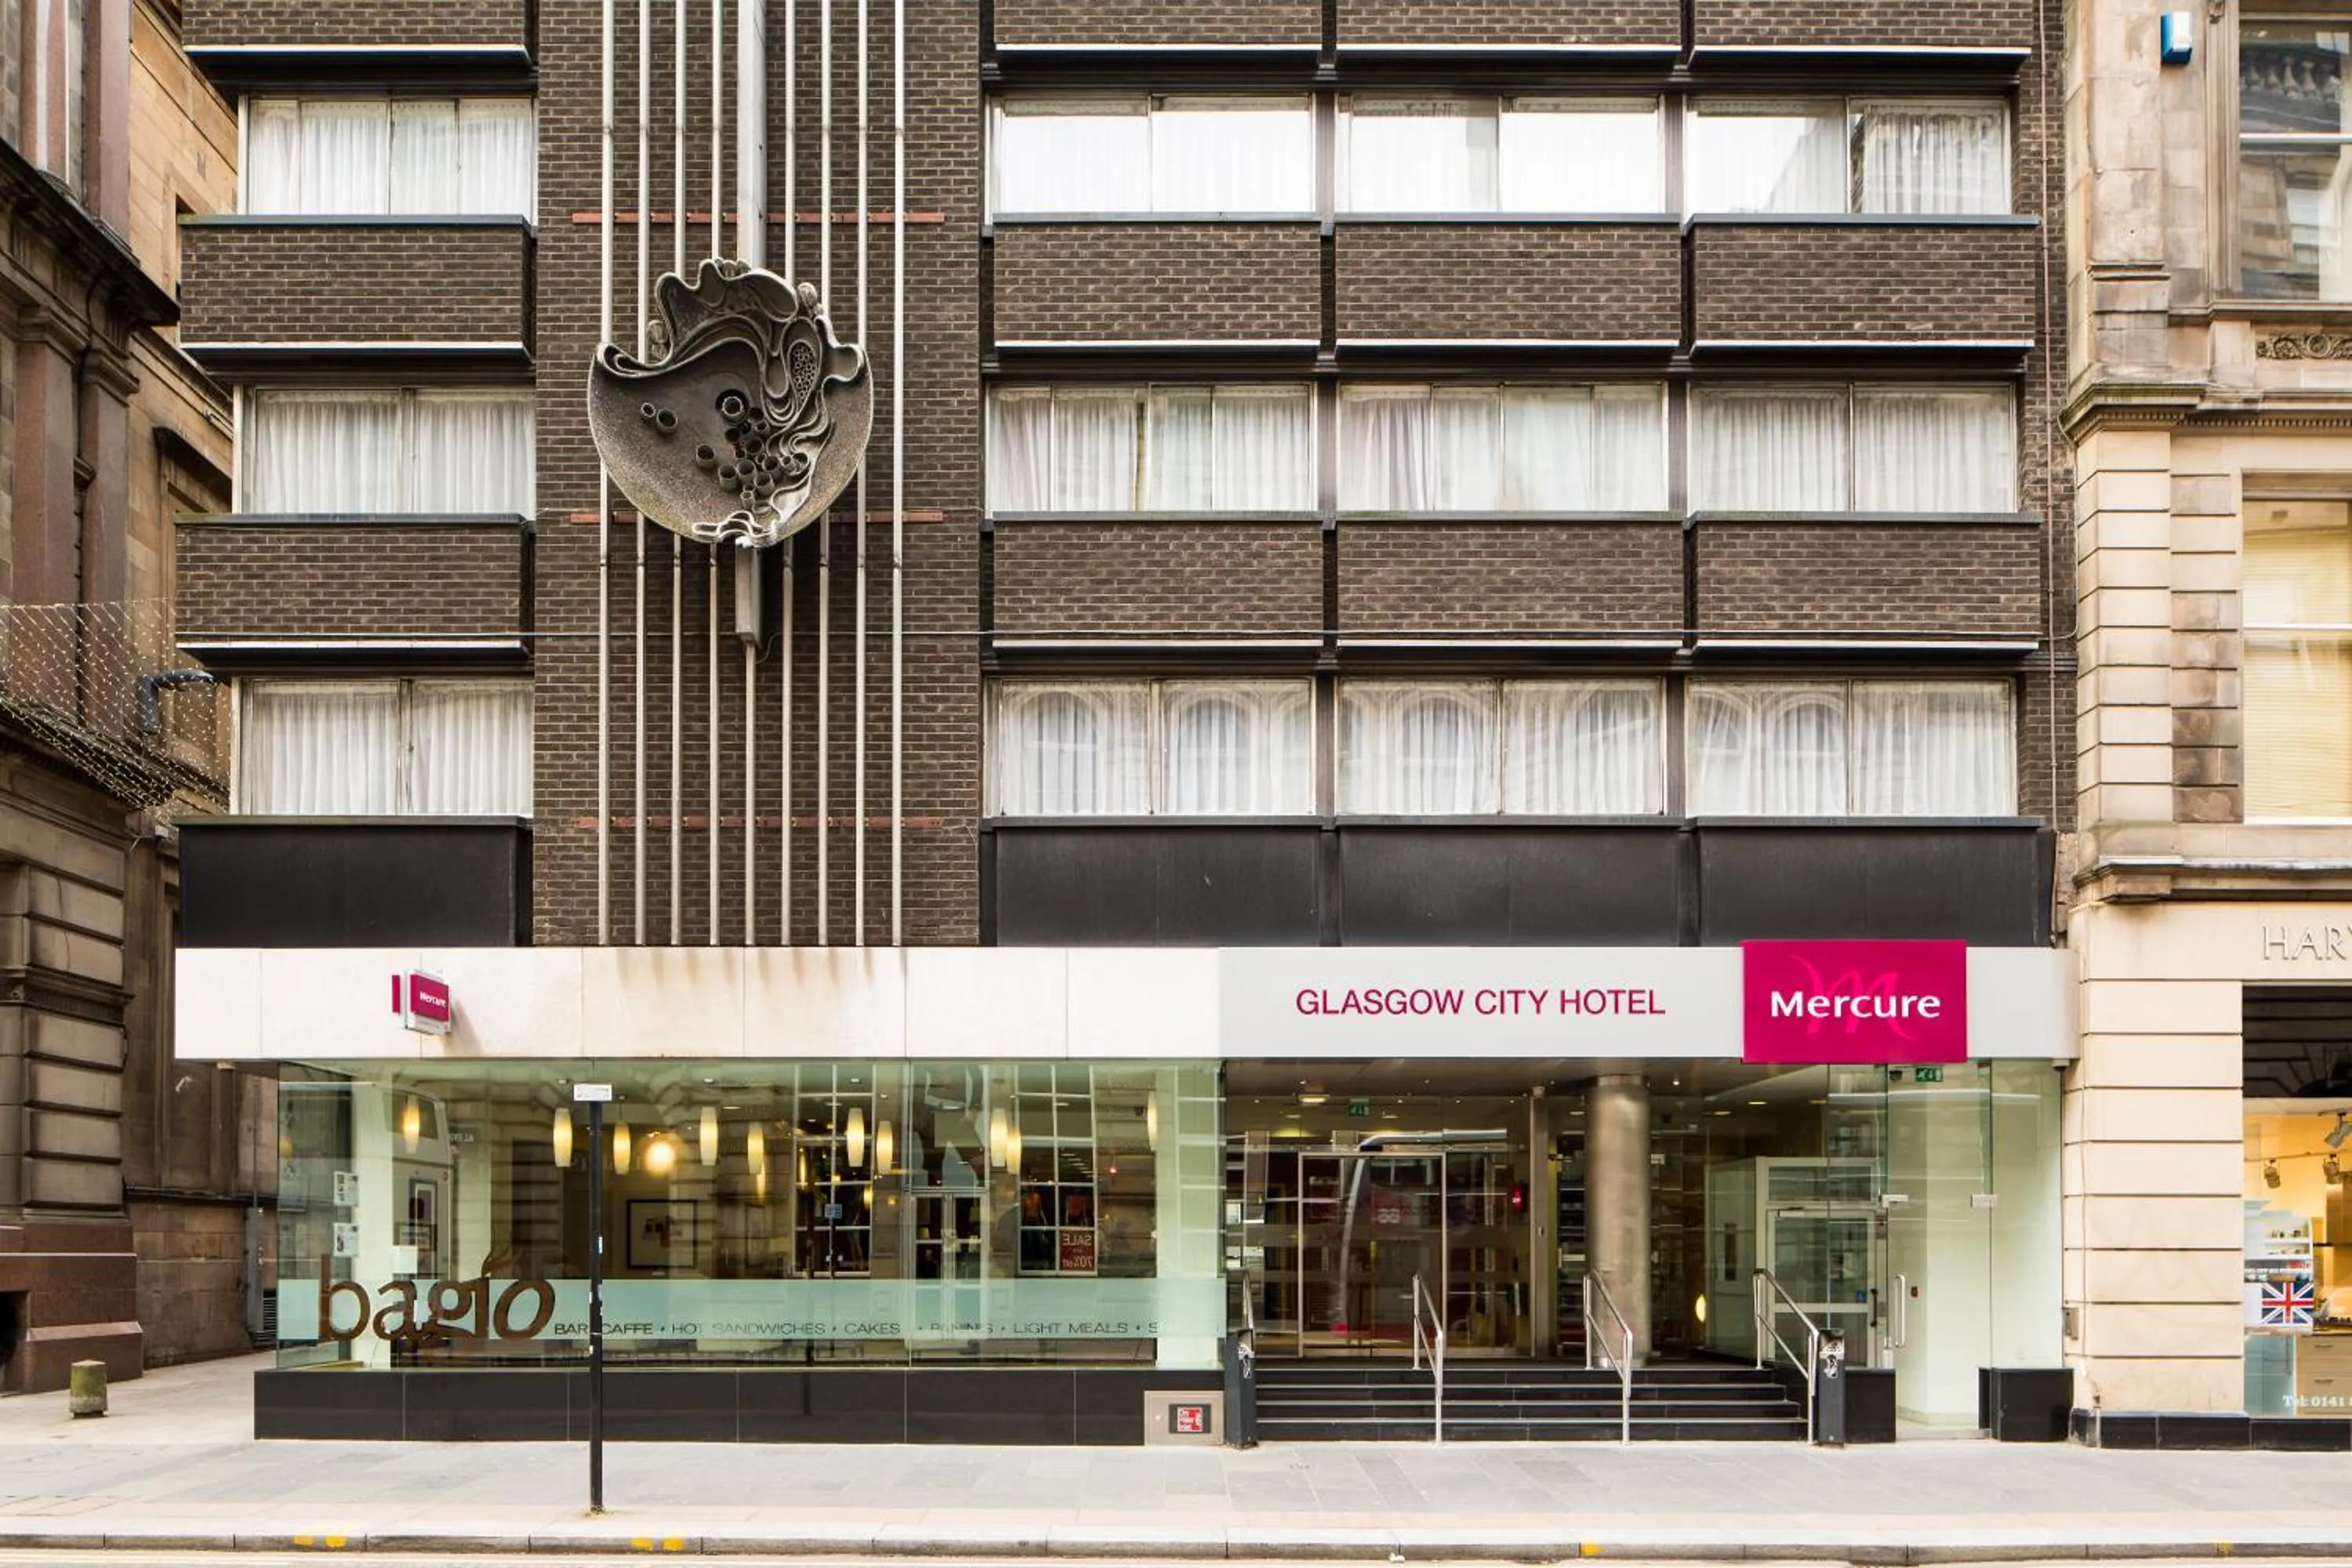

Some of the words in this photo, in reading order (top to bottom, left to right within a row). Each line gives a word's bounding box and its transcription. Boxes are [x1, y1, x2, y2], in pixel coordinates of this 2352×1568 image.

[2263, 925, 2352, 960] HAR
[1296, 989, 1464, 1015] GLASGOW
[1475, 989, 1549, 1015] CITY
[1559, 989, 1666, 1015] HOTEL
[1770, 990, 1941, 1018] Mercure
[554, 1323, 589, 1334] BAR
[601, 1323, 653, 1334] CAFFE
[672, 1323, 702, 1334] HOT
[712, 1323, 826, 1334] SANDWICHES
[844, 1323, 901, 1334] CAKES
[1014, 1323, 1061, 1334] LIGHT
[1069, 1323, 1128, 1333] MEALS
[2310, 1396, 2345, 1407] 0141
